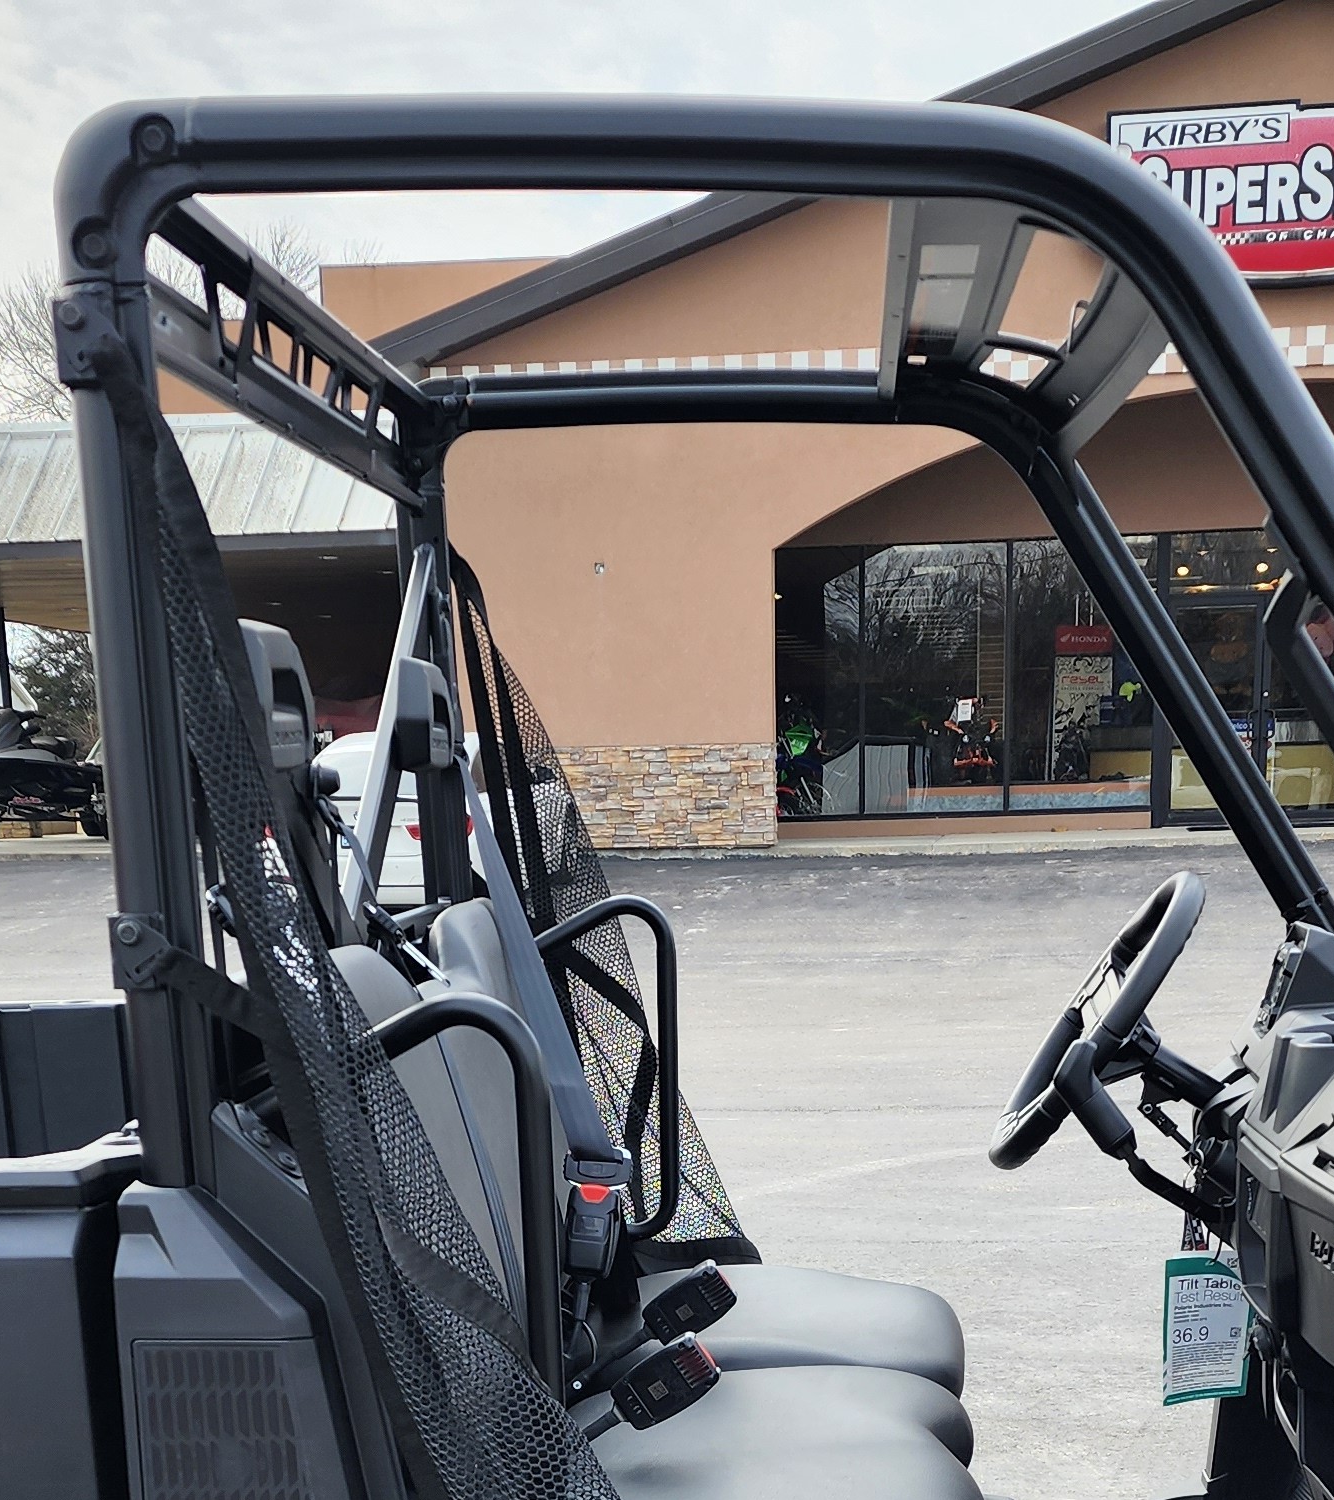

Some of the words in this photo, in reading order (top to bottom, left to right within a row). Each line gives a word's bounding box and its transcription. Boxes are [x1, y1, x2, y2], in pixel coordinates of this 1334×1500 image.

[1141, 115, 1283, 149] KIRBY'S
[1265, 229, 1289, 243] OF
[1070, 635, 1108, 643] HONDA
[1178, 1278, 1199, 1291] Tilt
[1203, 1277, 1242, 1291] Table
[1174, 1291, 1199, 1304] Test
[1203, 1289, 1244, 1302] Result
[1172, 1325, 1209, 1345] 36.9
